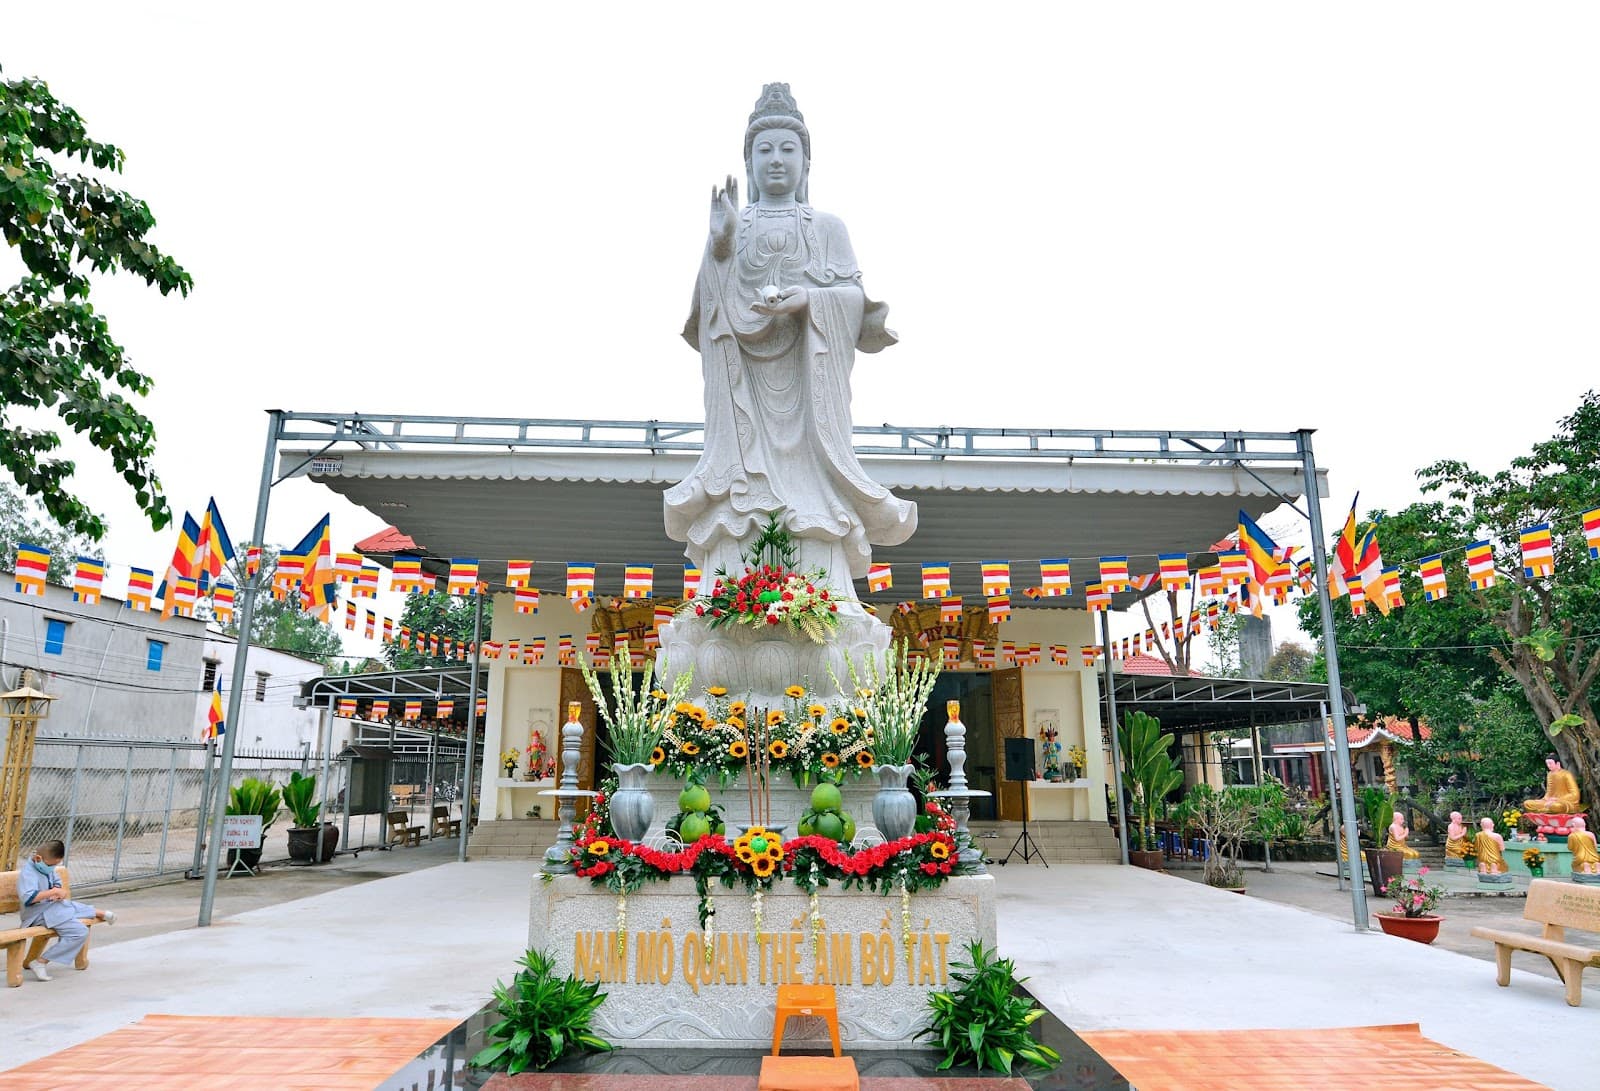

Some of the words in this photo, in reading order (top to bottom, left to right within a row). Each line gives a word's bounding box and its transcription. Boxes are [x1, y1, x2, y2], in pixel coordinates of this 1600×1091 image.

[574, 930, 628, 984] NAM
[635, 916, 675, 985] MÔ
[682, 930, 748, 996] QUAN
[758, 911, 808, 985] THẾ
[812, 917, 853, 985] ÂM
[860, 908, 895, 986] BỒ
[904, 917, 950, 985] TÁT
